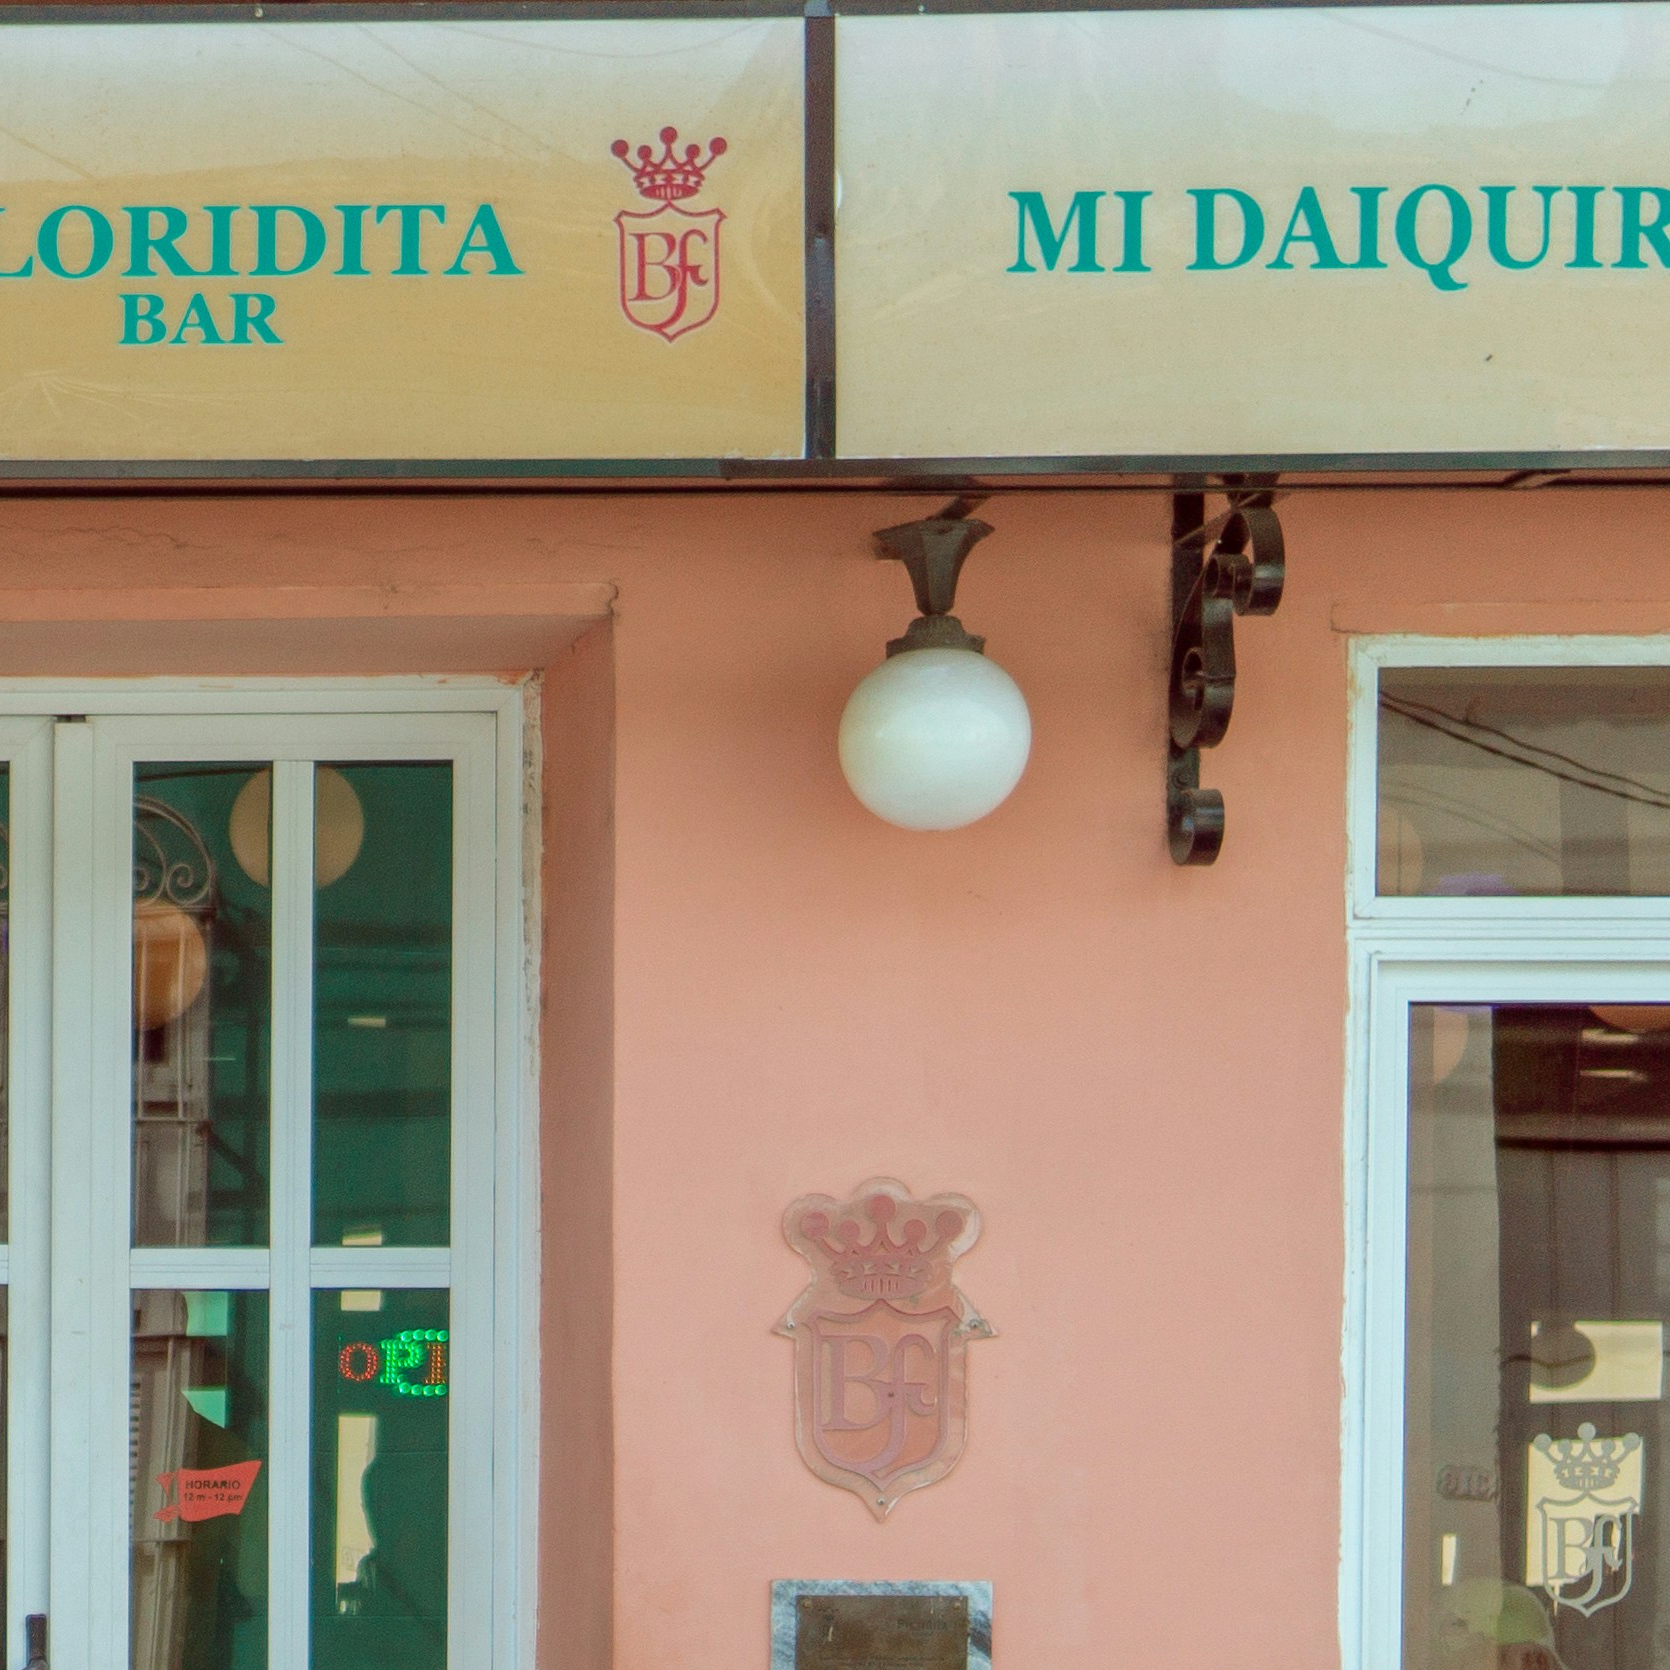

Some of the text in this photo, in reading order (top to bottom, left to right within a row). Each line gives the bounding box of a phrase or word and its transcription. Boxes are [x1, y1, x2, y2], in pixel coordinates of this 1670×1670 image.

[1006, 184, 1670, 292] MI DAIQUIR
[118, 293, 285, 347] BAR
[185, 1480, 241, 1490] HORARIO
